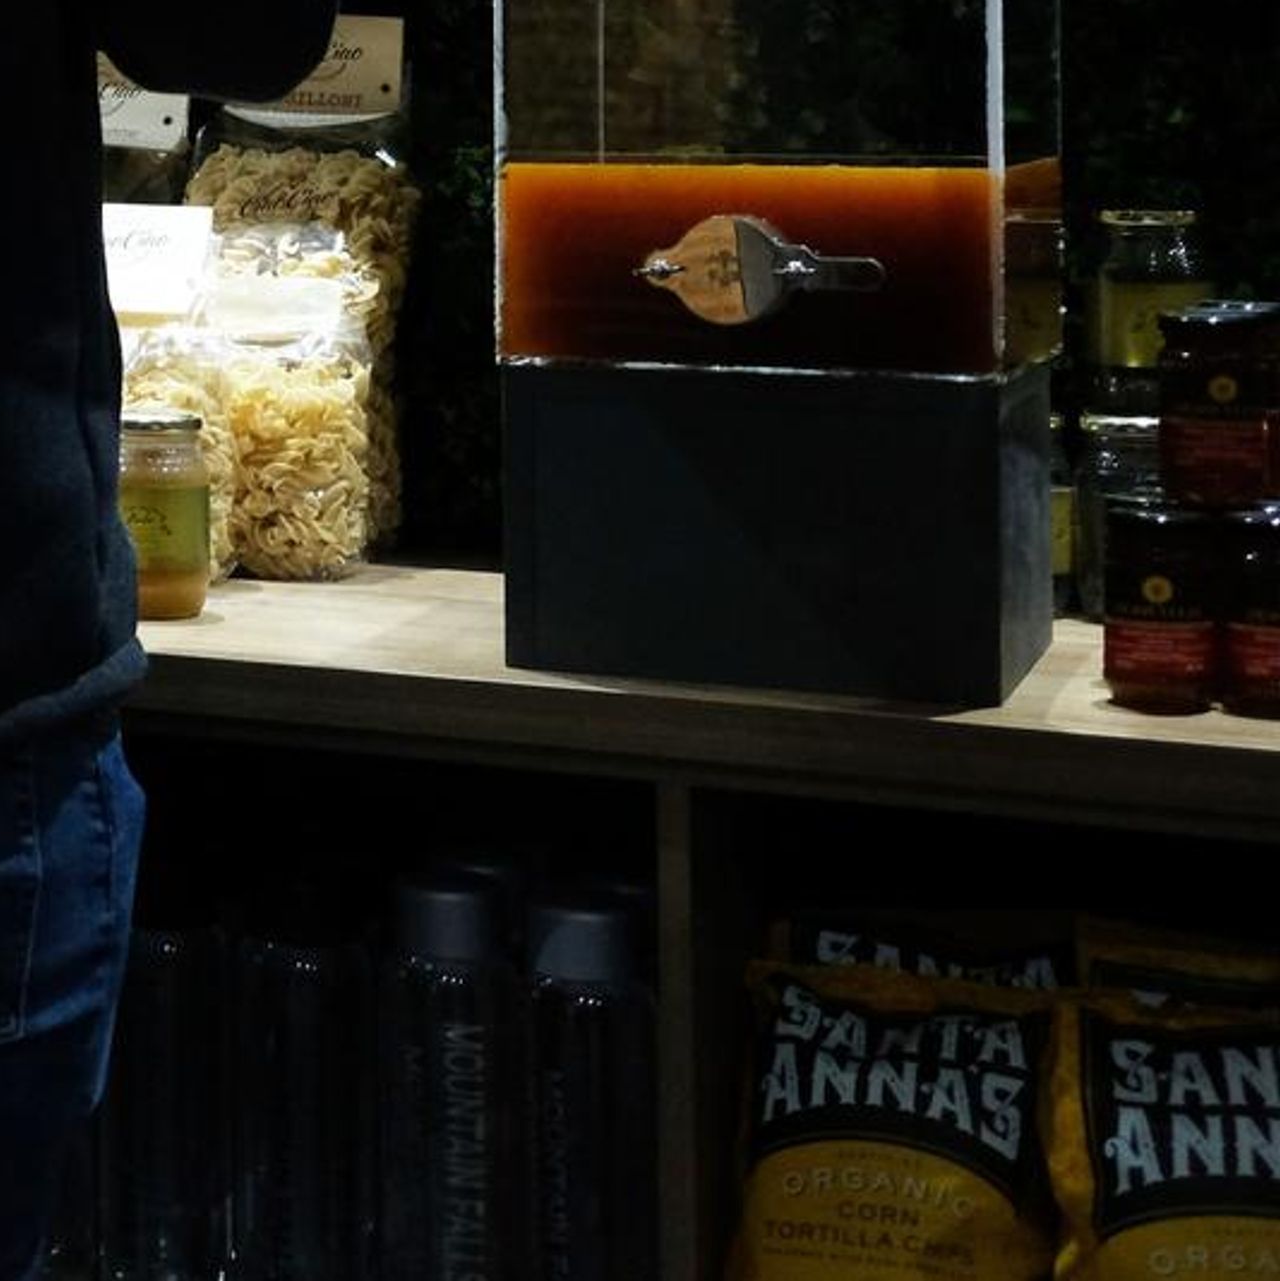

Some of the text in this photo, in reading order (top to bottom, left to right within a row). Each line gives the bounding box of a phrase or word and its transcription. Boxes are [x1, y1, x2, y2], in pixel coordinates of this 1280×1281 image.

[761, 1041, 1023, 1162] ANNAS
[1107, 1037, 1280, 1107] SAN
[444, 1024, 487, 1189] MOUNTAIN
[1104, 1104, 1280, 1198] ANN
[782, 1166, 977, 1219] ORGANIC
[838, 1202, 922, 1228] CORN
[762, 1219, 895, 1250] TORTILLA
[1147, 1243, 1278, 1276] ORGA
